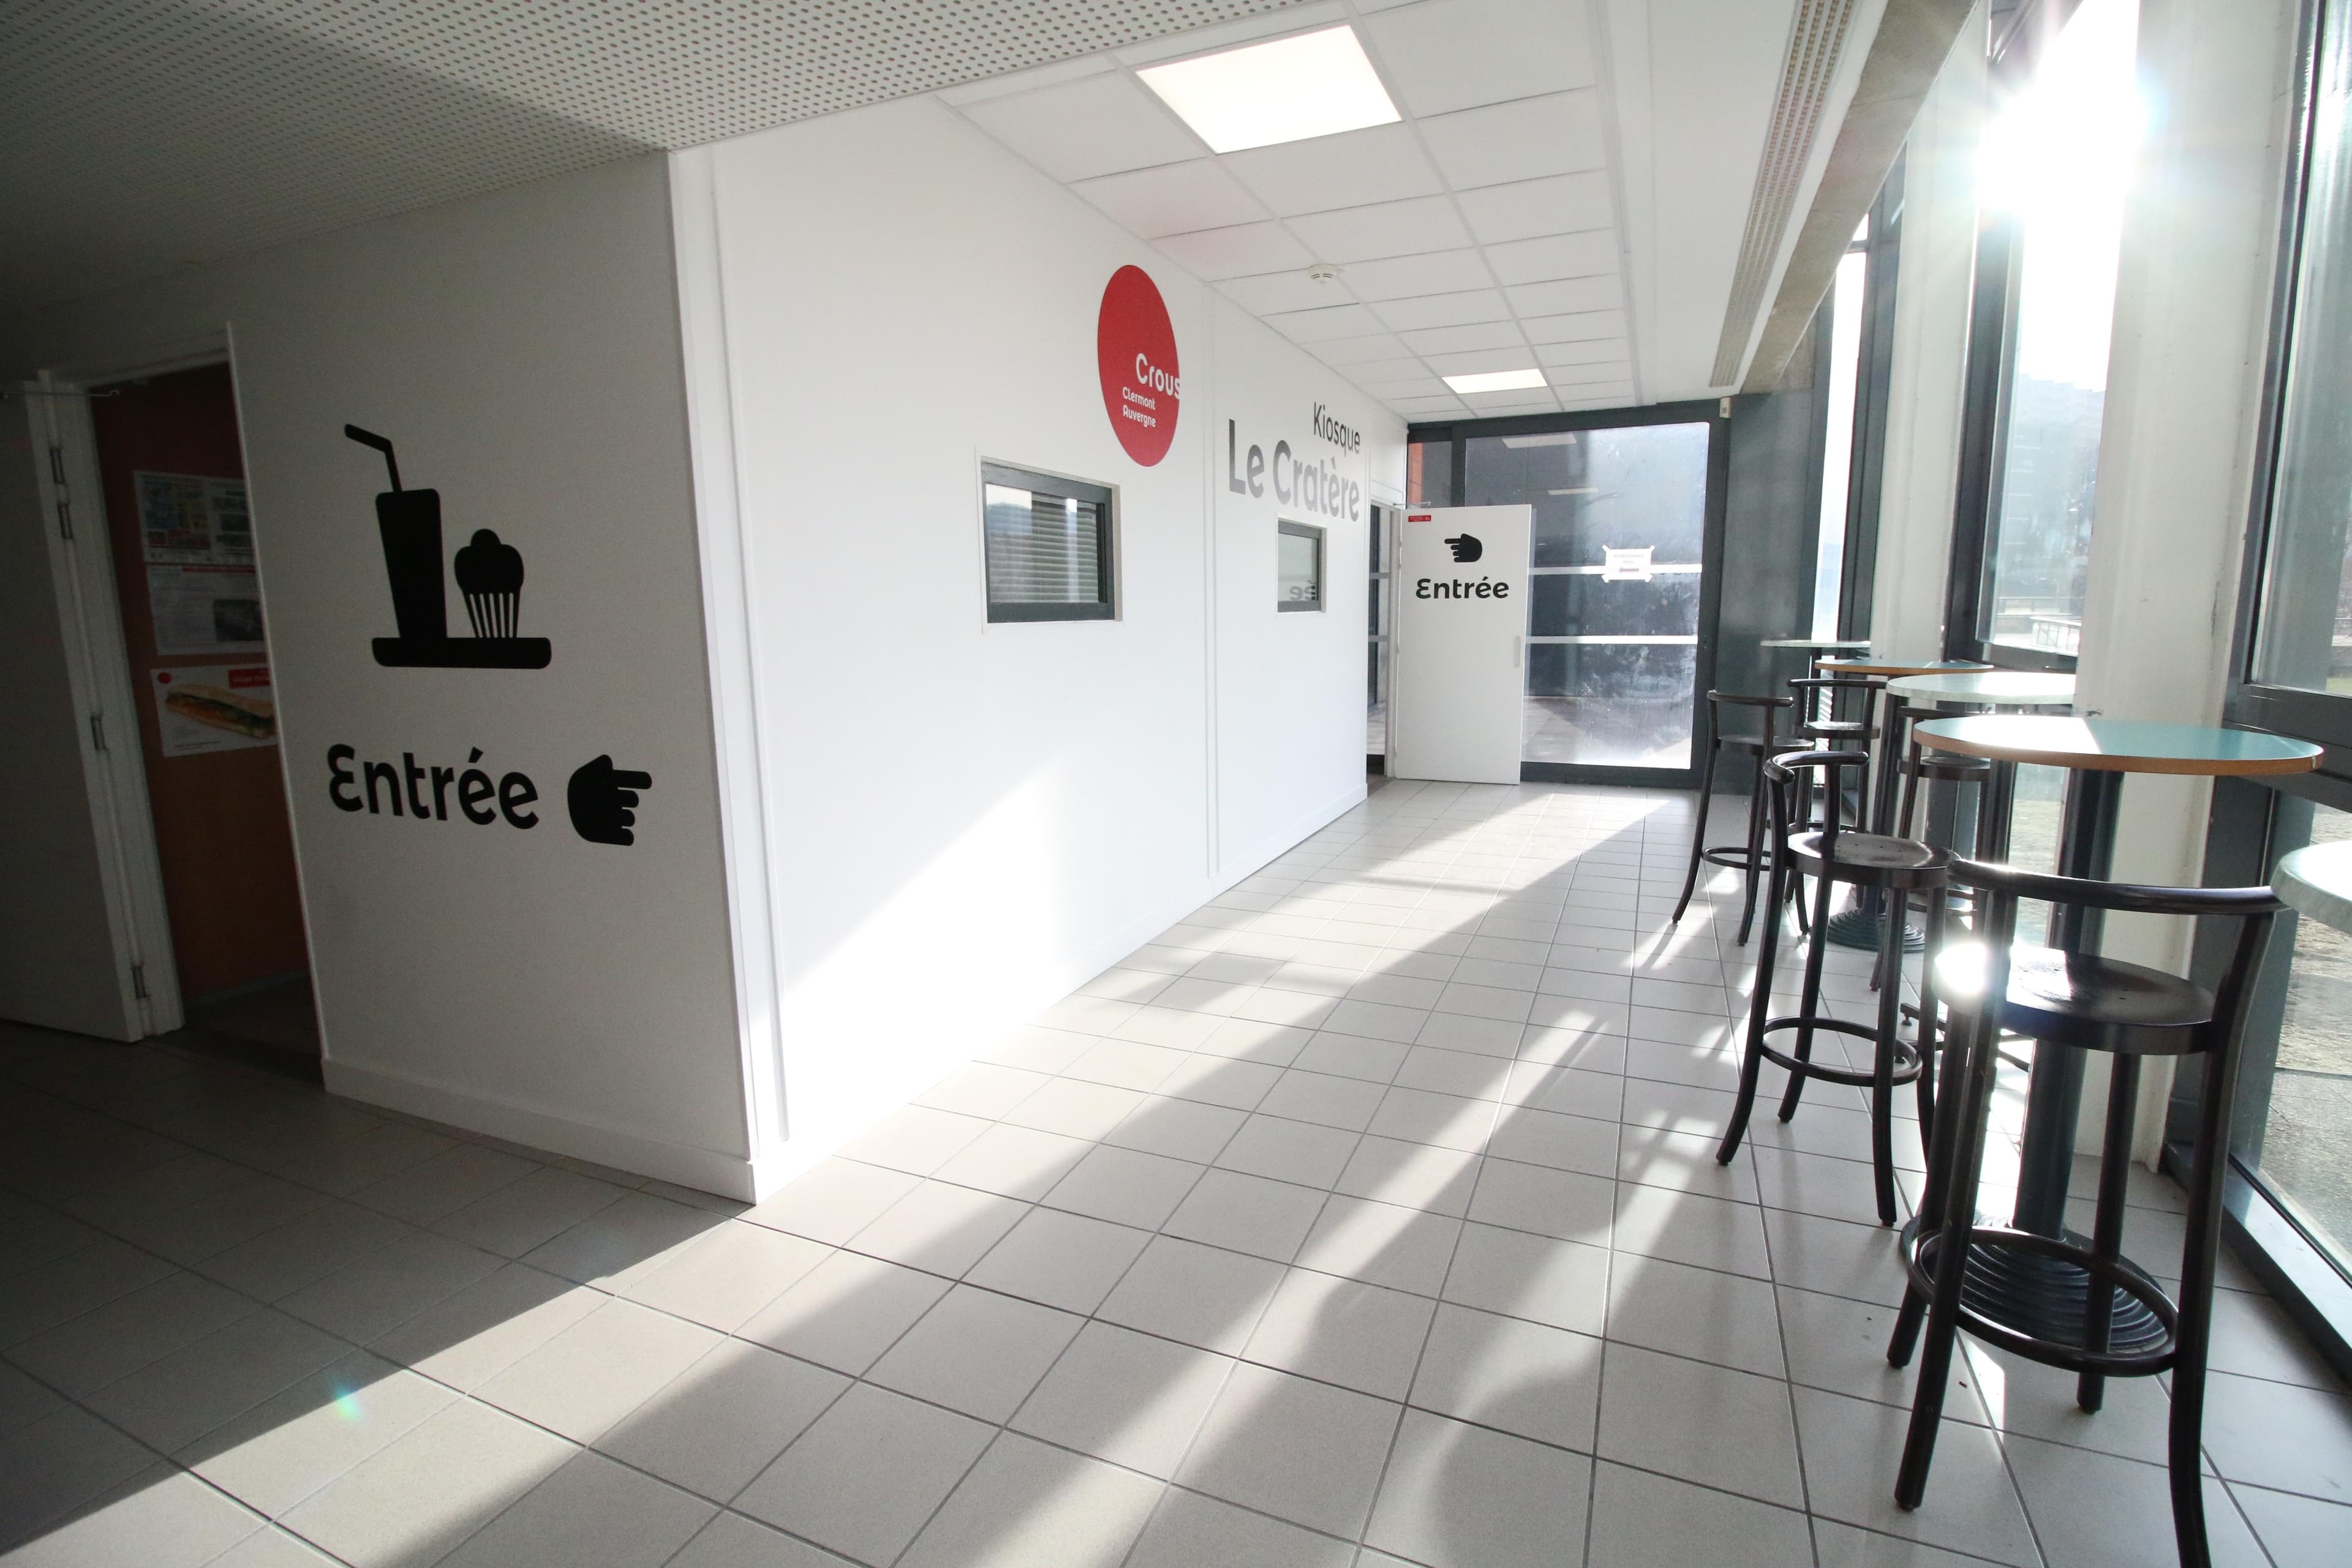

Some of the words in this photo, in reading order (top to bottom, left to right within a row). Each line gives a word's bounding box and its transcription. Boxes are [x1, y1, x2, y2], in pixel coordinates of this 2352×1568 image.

[1122, 386, 1156, 410] Clermont
[1136, 353, 1180, 400] Crous
[1123, 404, 1156, 428] Auvergne
[1314, 402, 1360, 456] Kiosque
[1228, 418, 1265, 499] Le
[1273, 440, 1360, 522] Cratère
[1415, 576, 1509, 599] Entrée
[327, 744, 540, 829] Entrée
